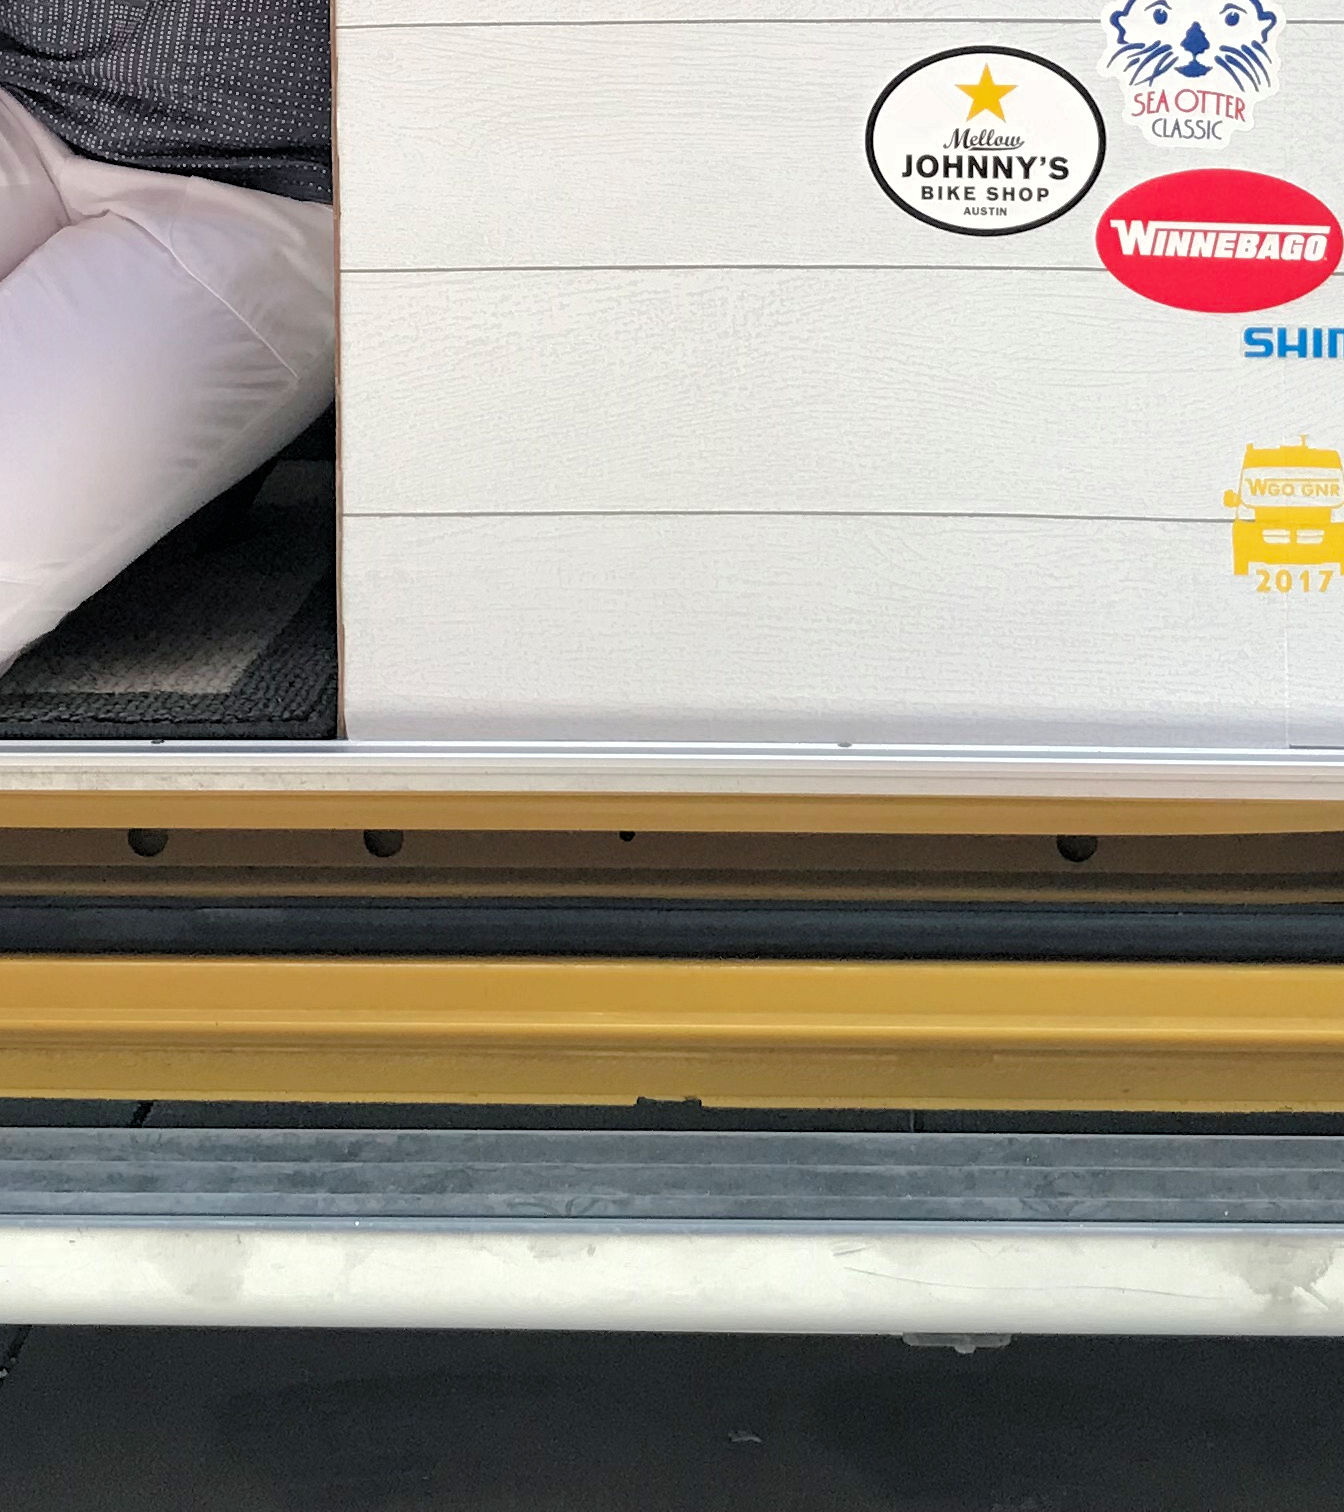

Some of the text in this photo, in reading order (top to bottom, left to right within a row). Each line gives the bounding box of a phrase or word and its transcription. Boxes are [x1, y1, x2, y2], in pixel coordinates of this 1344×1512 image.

[1131, 88, 1246, 122] SEA OTTER
[942, 127, 1025, 151] Mellow
[1151, 118, 1224, 141] CLASSIC
[901, 153, 1070, 180] JOHNNY'S
[920, 185, 1050, 203] BIKE SHOP
[962, 205, 1008, 217] AUSTIN
[1110, 219, 1331, 262] WINNEBAGO
[1255, 568, 1335, 594] 2017
